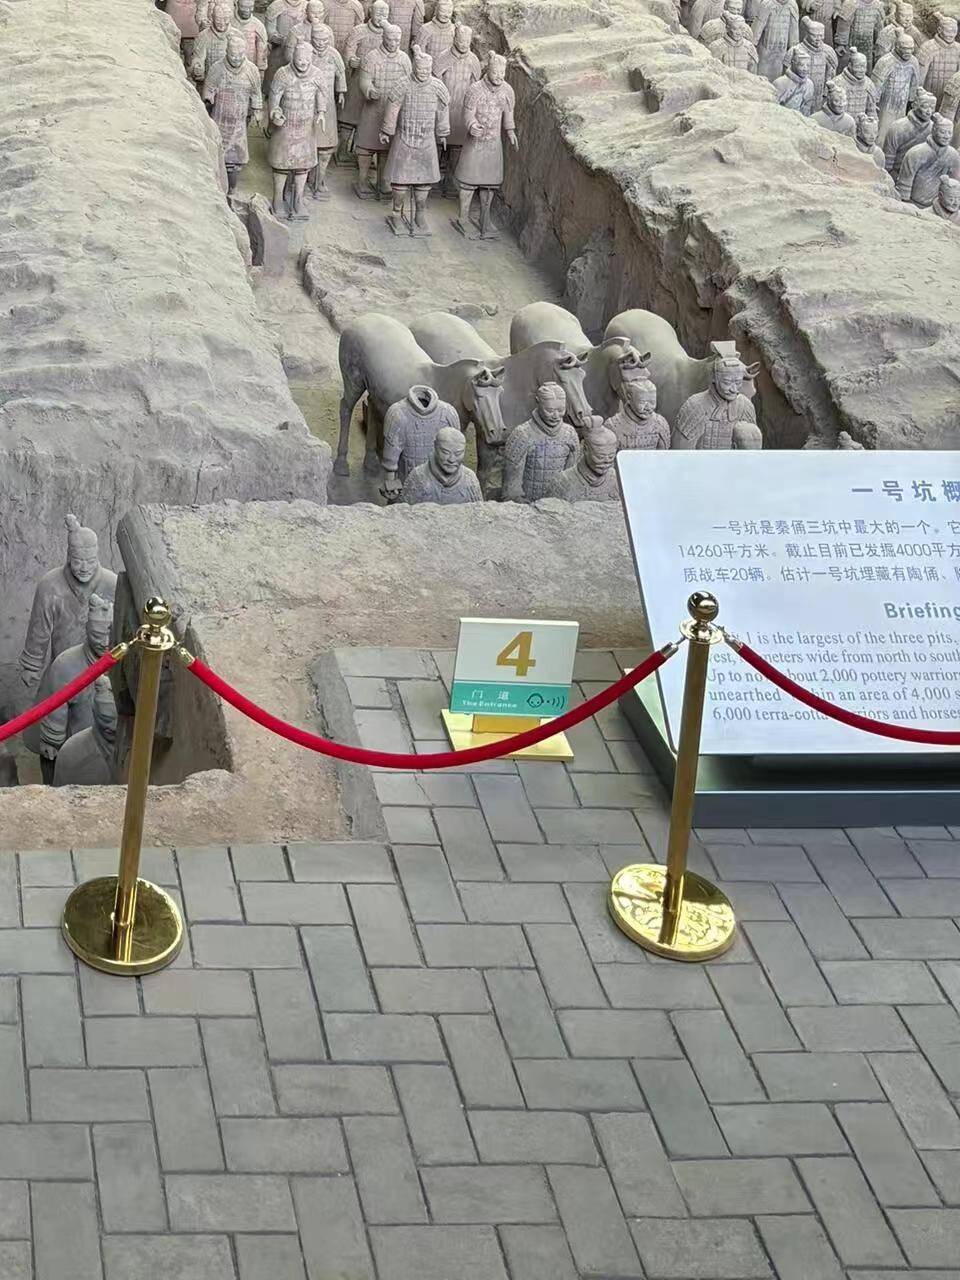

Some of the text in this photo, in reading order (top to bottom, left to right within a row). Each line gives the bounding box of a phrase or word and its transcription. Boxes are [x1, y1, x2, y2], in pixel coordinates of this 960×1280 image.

[851, 479, 960, 502] 一号坑概
[884, 602, 960, 621] Briefing
[757, 631, 770, 645] is
[772, 631, 794, 645] the
[798, 631, 846, 648] largest
[847, 631, 861, 645] of
[864, 631, 886, 645] the
[889, 631, 924, 645] three
[496, 631, 536, 677] 4
[709, 652, 736, 666] est,
[806, 649, 839, 663] wide
[842, 649, 873, 663] from
[877, 649, 911, 663] north
[913, 651, 927, 663] to
[728, 670, 742, 682] to
[745, 671, 763, 683] no
[787, 668, 818, 682] bout
[820, 668, 858, 684] 2,000
[861, 669, 907, 685] pottery
[910, 667, 960, 682] warrior
[709, 687, 782, 701] unearthed
[839, 690, 856, 701] an
[859, 690, 889, 702] area
[892, 687, 908, 701] of
[911, 687, 951, 702] 4,000
[712, 706, 752, 722] 6,000
[755, 708, 828, 721] terra-cott
[892, 706, 917, 721] and
